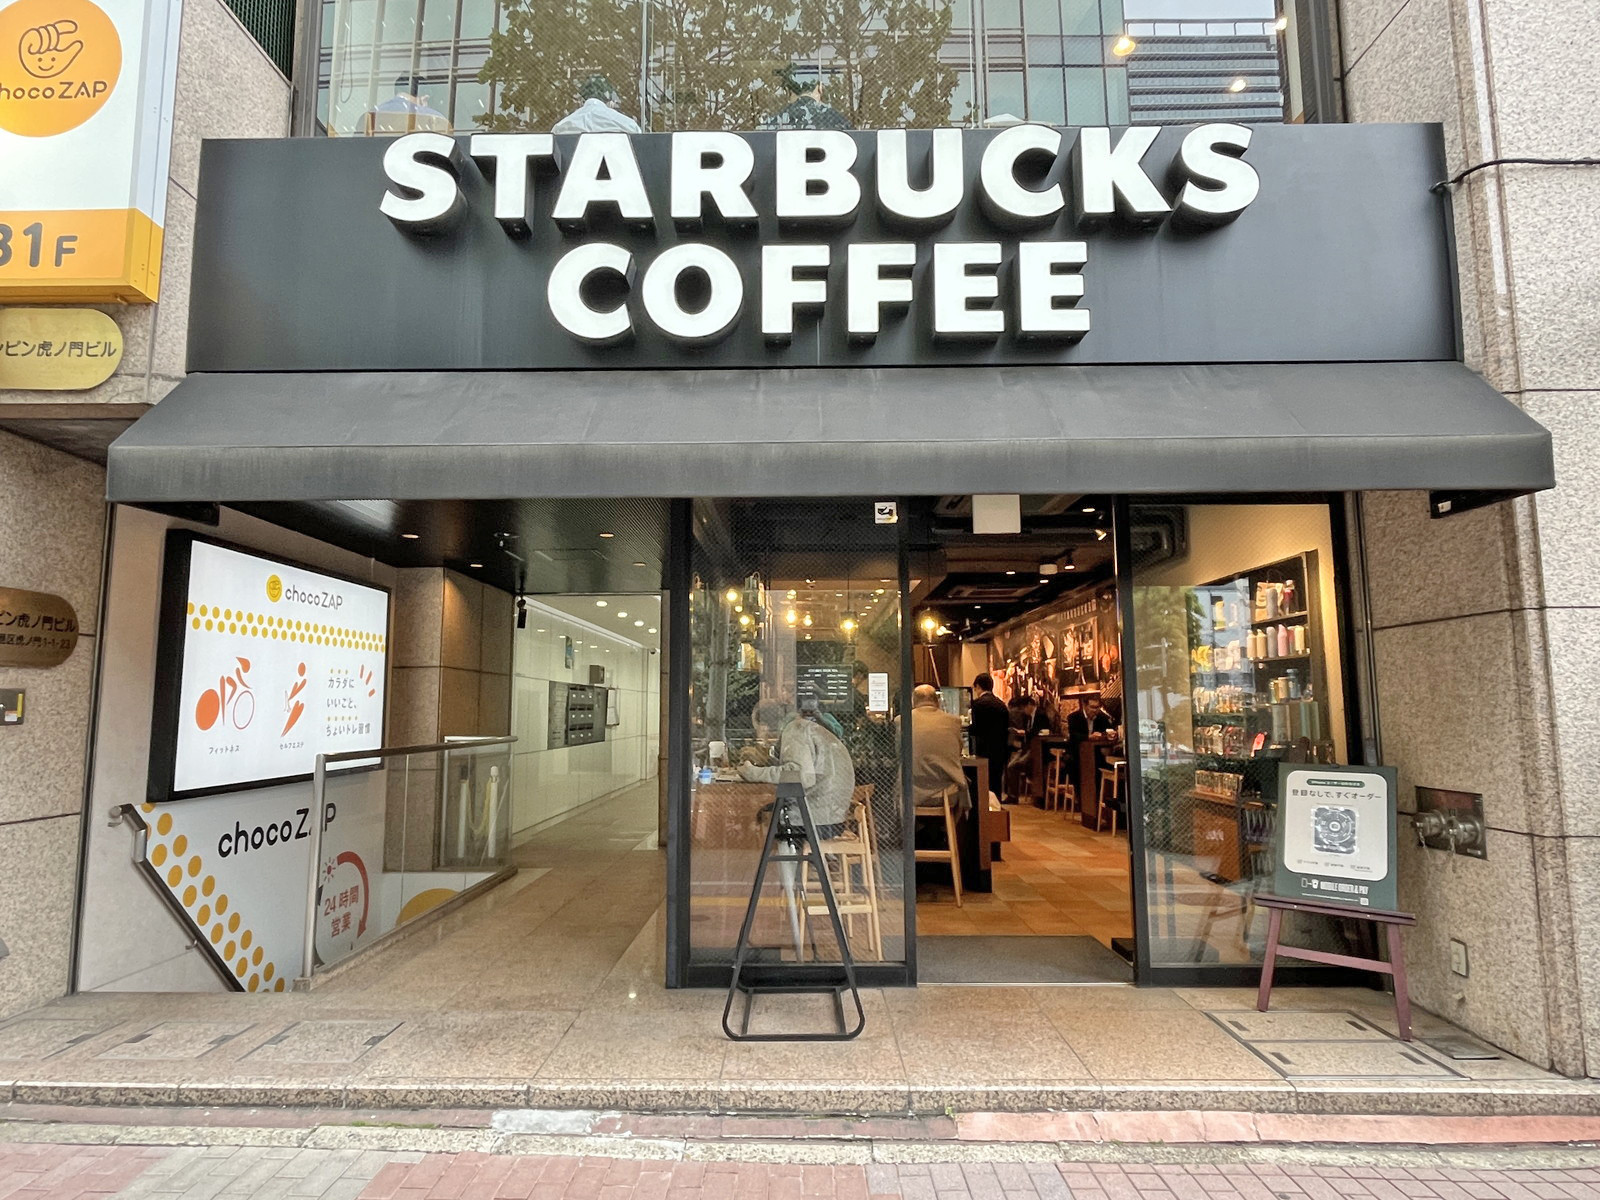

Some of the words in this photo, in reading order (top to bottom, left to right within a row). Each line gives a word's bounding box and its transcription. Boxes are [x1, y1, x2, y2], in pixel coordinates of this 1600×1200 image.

[379, 122, 1261, 223] STARBUCKS
[547, 240, 1092, 340] COFFEE
[0, 340, 117, 358] ピン虎ノ門ビル
[285, 583, 343, 611] chocoZAP
[328, 677, 355, 689] カラダに
[208, 744, 240, 755] フィットネス
[218, 802, 337, 858] chocoZP
[331, 911, 351, 938] 営業
